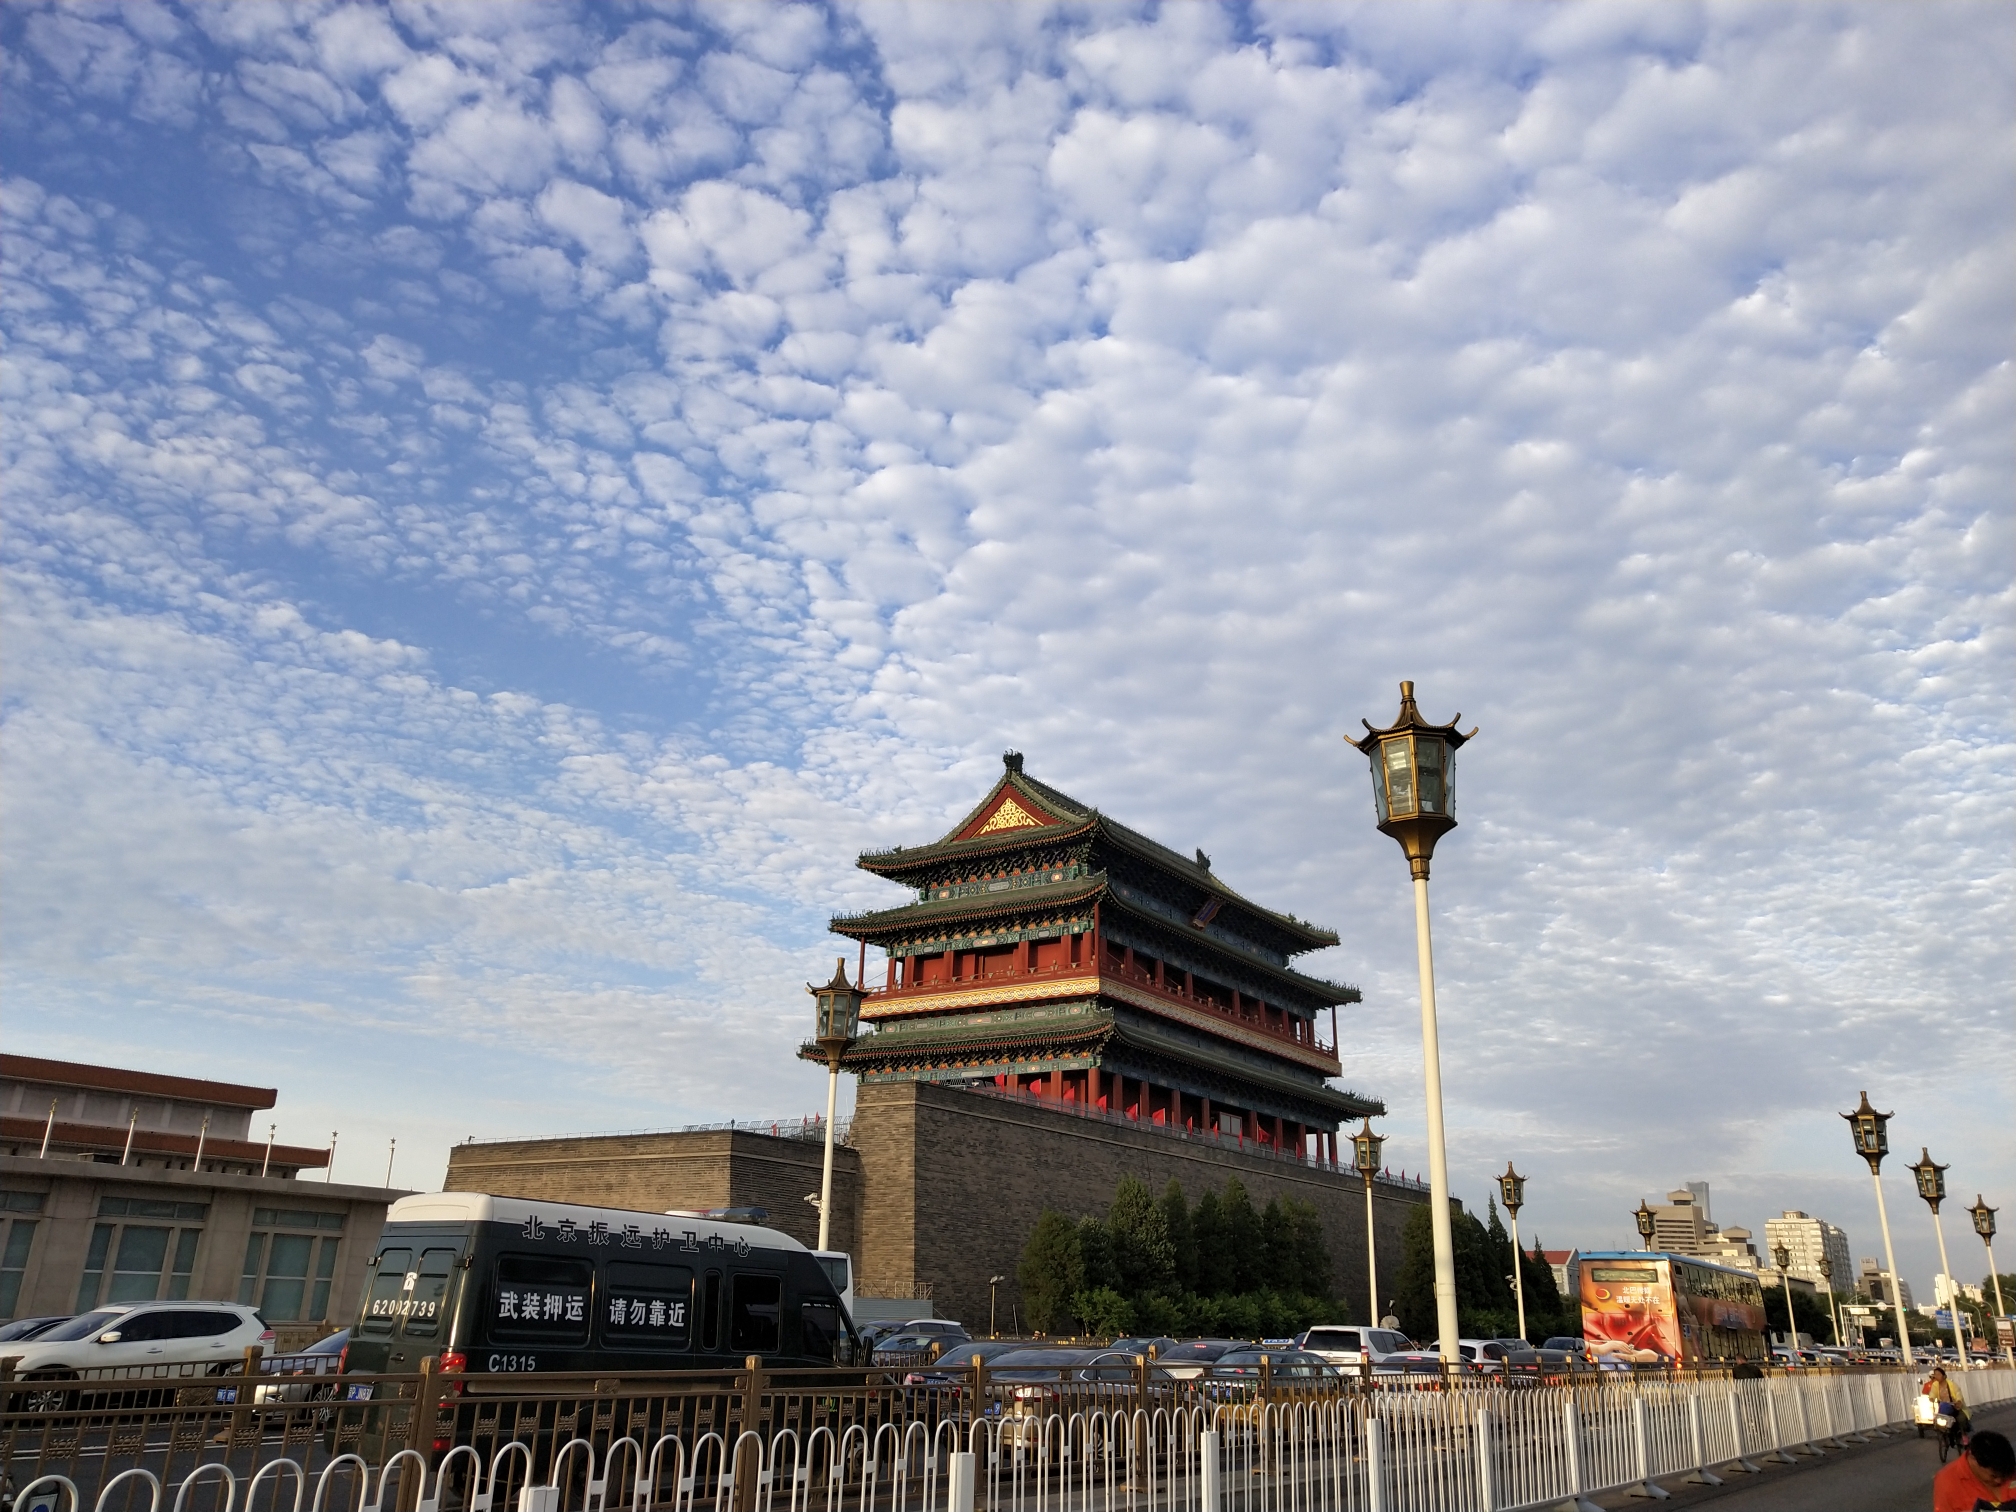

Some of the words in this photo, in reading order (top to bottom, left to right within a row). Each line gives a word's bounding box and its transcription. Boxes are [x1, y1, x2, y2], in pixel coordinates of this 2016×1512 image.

[522, 1215, 751, 1258] 北京振远护卫中心
[372, 1299, 436, 1317] 62002739
[499, 1291, 584, 1321] 武装押运
[609, 1298, 685, 1327] 请勿靠近
[489, 1354, 536, 1372] C1315
